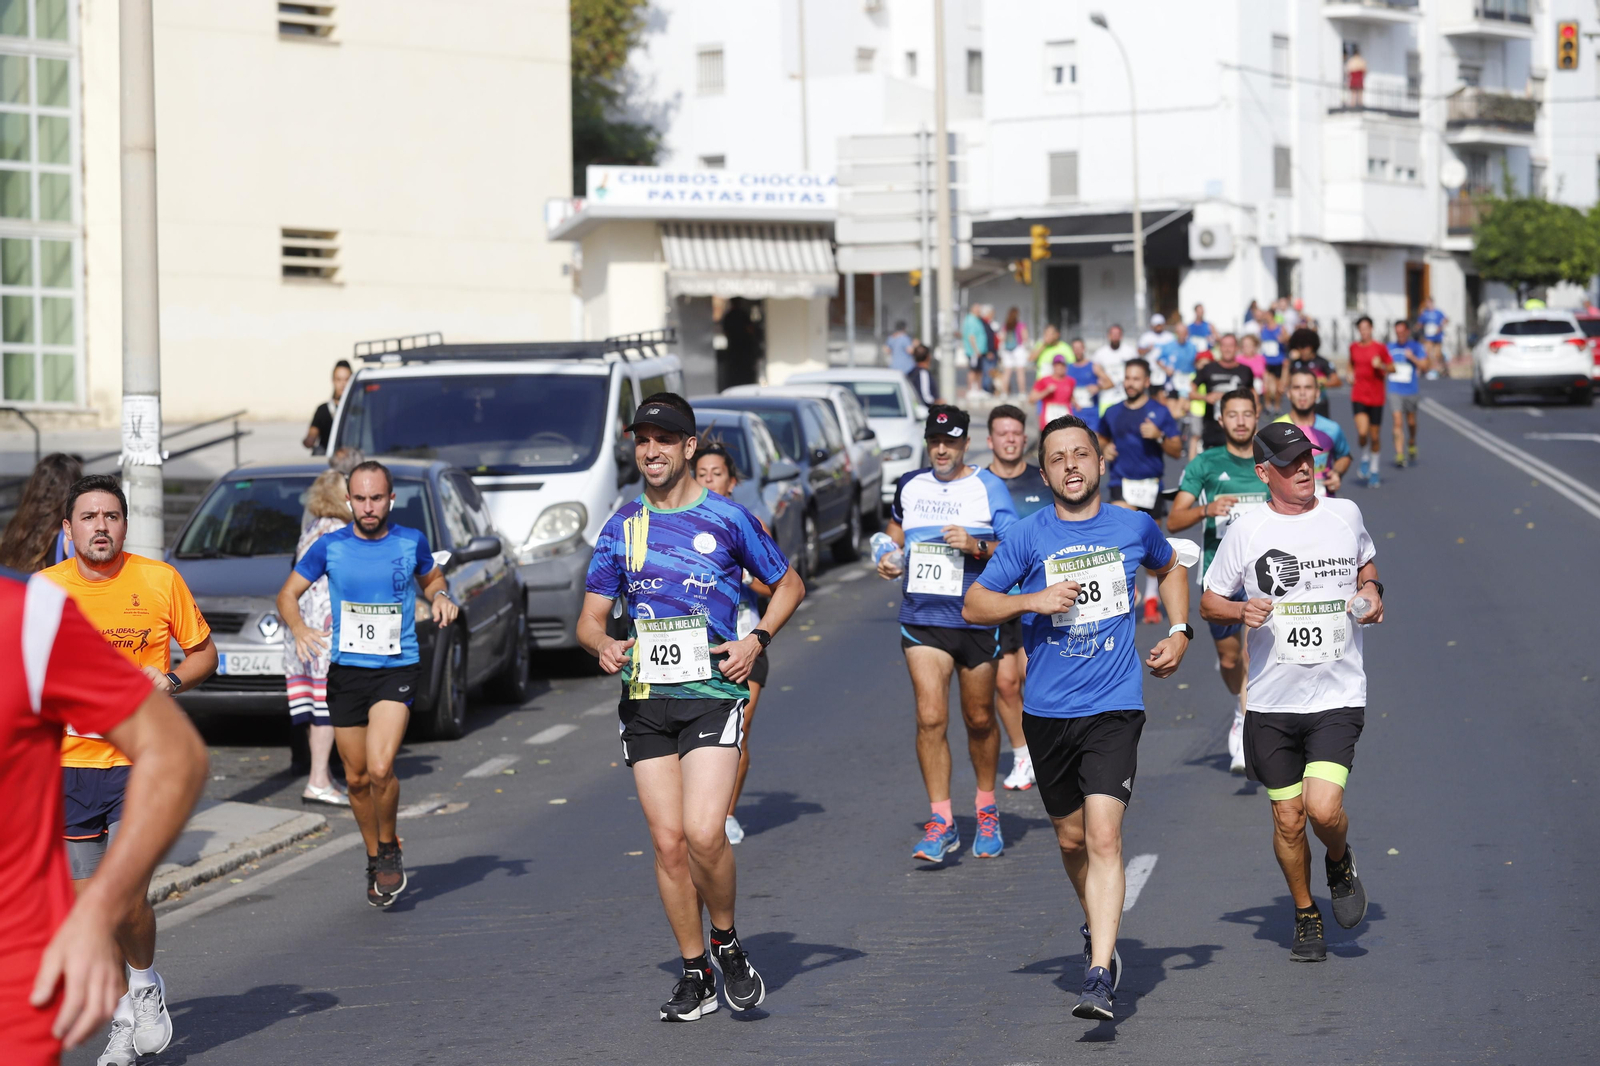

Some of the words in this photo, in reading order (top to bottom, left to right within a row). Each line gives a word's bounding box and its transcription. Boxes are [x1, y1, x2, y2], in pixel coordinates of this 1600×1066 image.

[618, 171, 720, 186] CHURROS
[648, 189, 744, 202] PATATAS
[752, 192, 826, 204] FRITAS
[917, 498, 952, 508] RUNNERS
[1025, 495, 1040, 503] FILA
[914, 504, 960, 516] PALMERA
[1056, 544, 1087, 556] VUELTA
[1060, 559, 1085, 573] VUELTA
[1086, 557, 1092, 567] A
[1092, 552, 1116, 565] HUELVA
[1300, 557, 1356, 571] RUNNING
[916, 563, 942, 580] 270
[1314, 568, 1351, 579] MMH21
[1072, 580, 1102, 605] 58
[1287, 604, 1312, 614] VUELTA
[1312, 605, 1318, 613] A
[1318, 602, 1342, 613] HUELVA
[102, 628, 114, 636] LAS
[115, 627, 136, 635] IDEAS
[357, 623, 375, 640] 18
[648, 621, 668, 631] VUELTA
[668, 620, 674, 630] A
[674, 618, 701, 630] HUELVA
[1286, 626, 1323, 648] 493
[650, 643, 682, 666] 429
[230, 655, 271, 672] 9244
